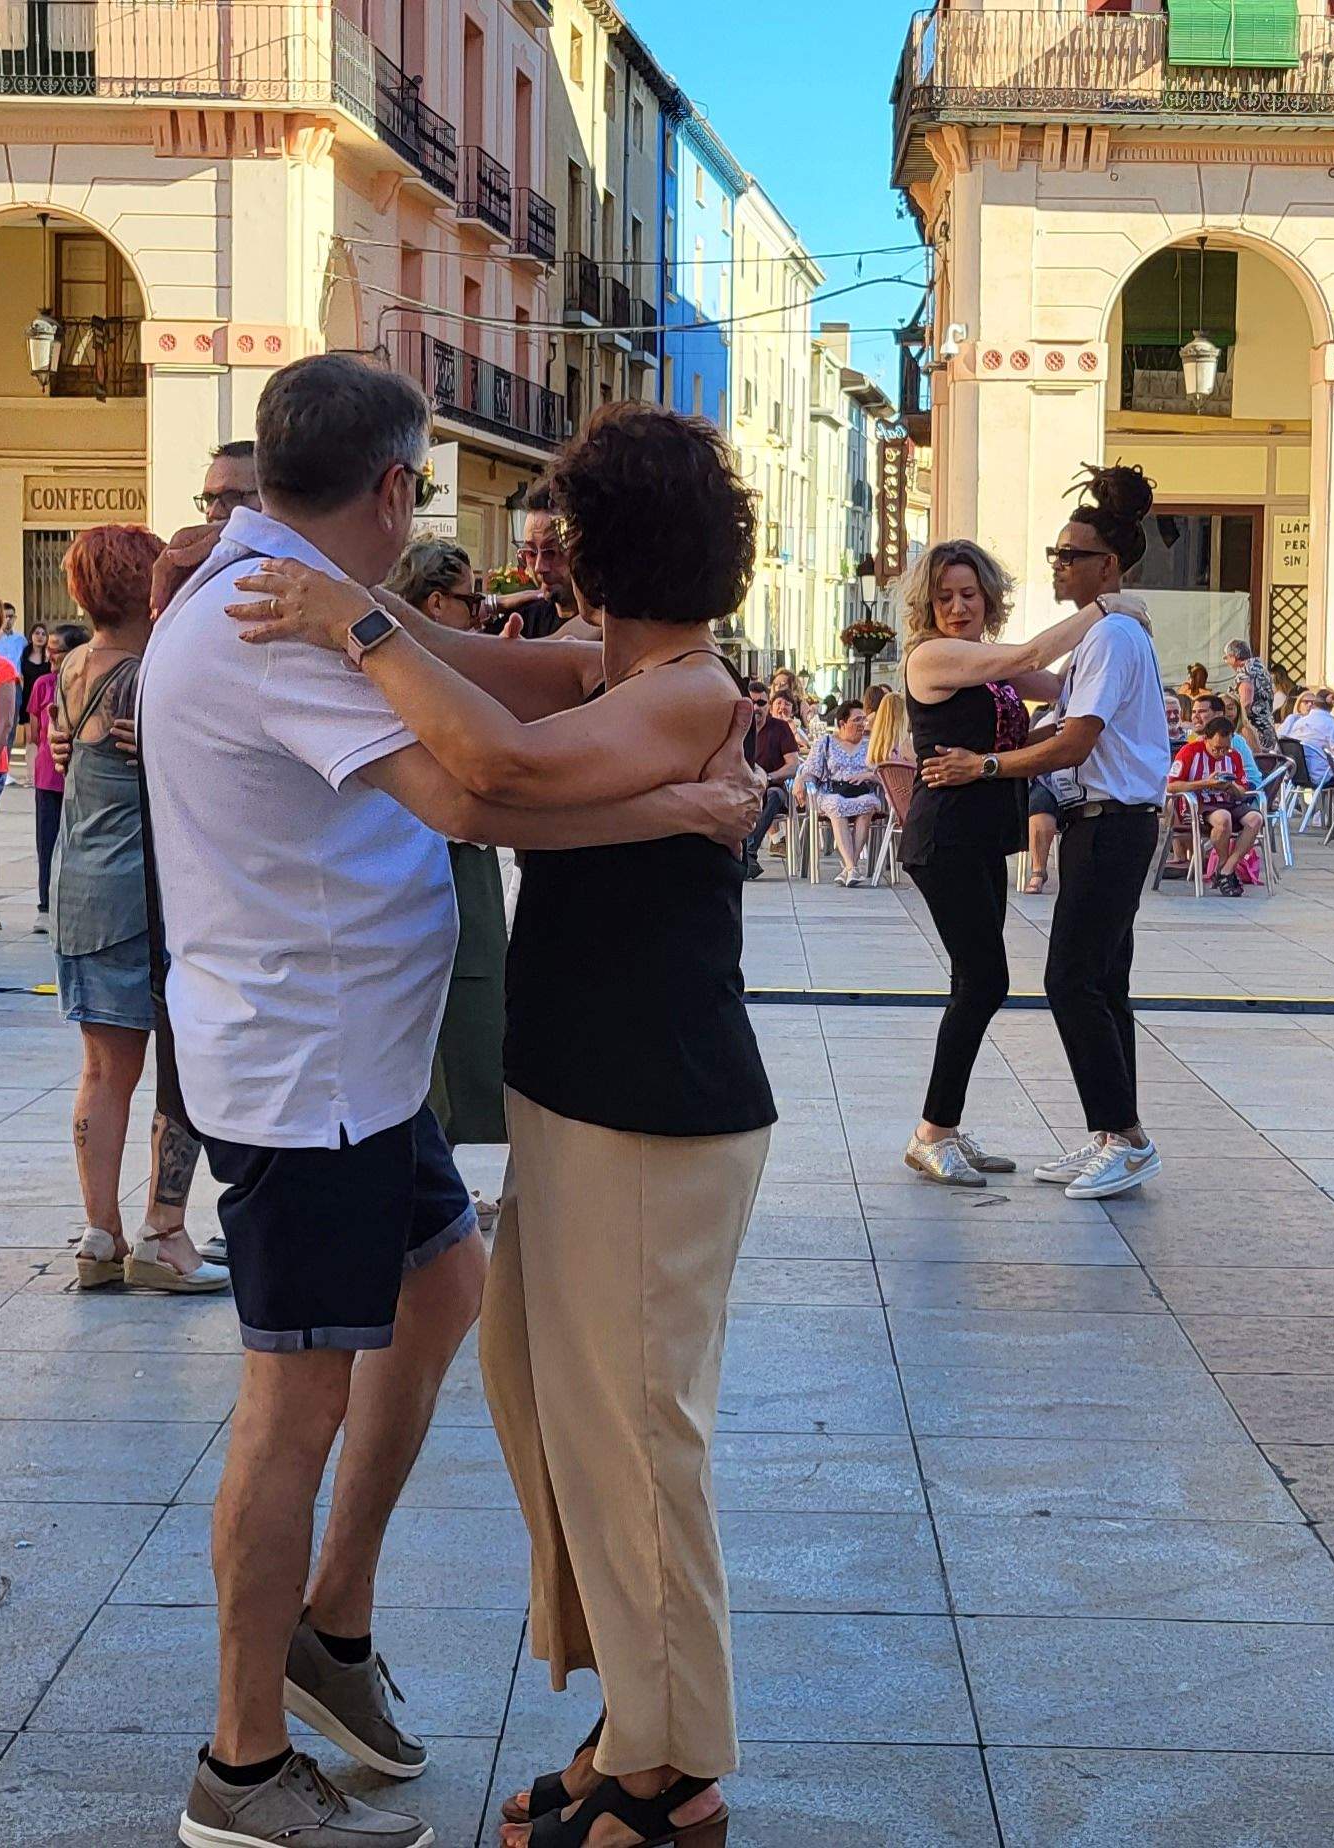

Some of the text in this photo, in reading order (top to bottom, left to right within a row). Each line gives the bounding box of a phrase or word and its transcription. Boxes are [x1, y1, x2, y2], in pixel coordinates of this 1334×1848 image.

[30, 487, 147, 511] CONFECCION
[1284, 540, 1310, 551] PER
[1283, 555, 1301, 567] SIN
